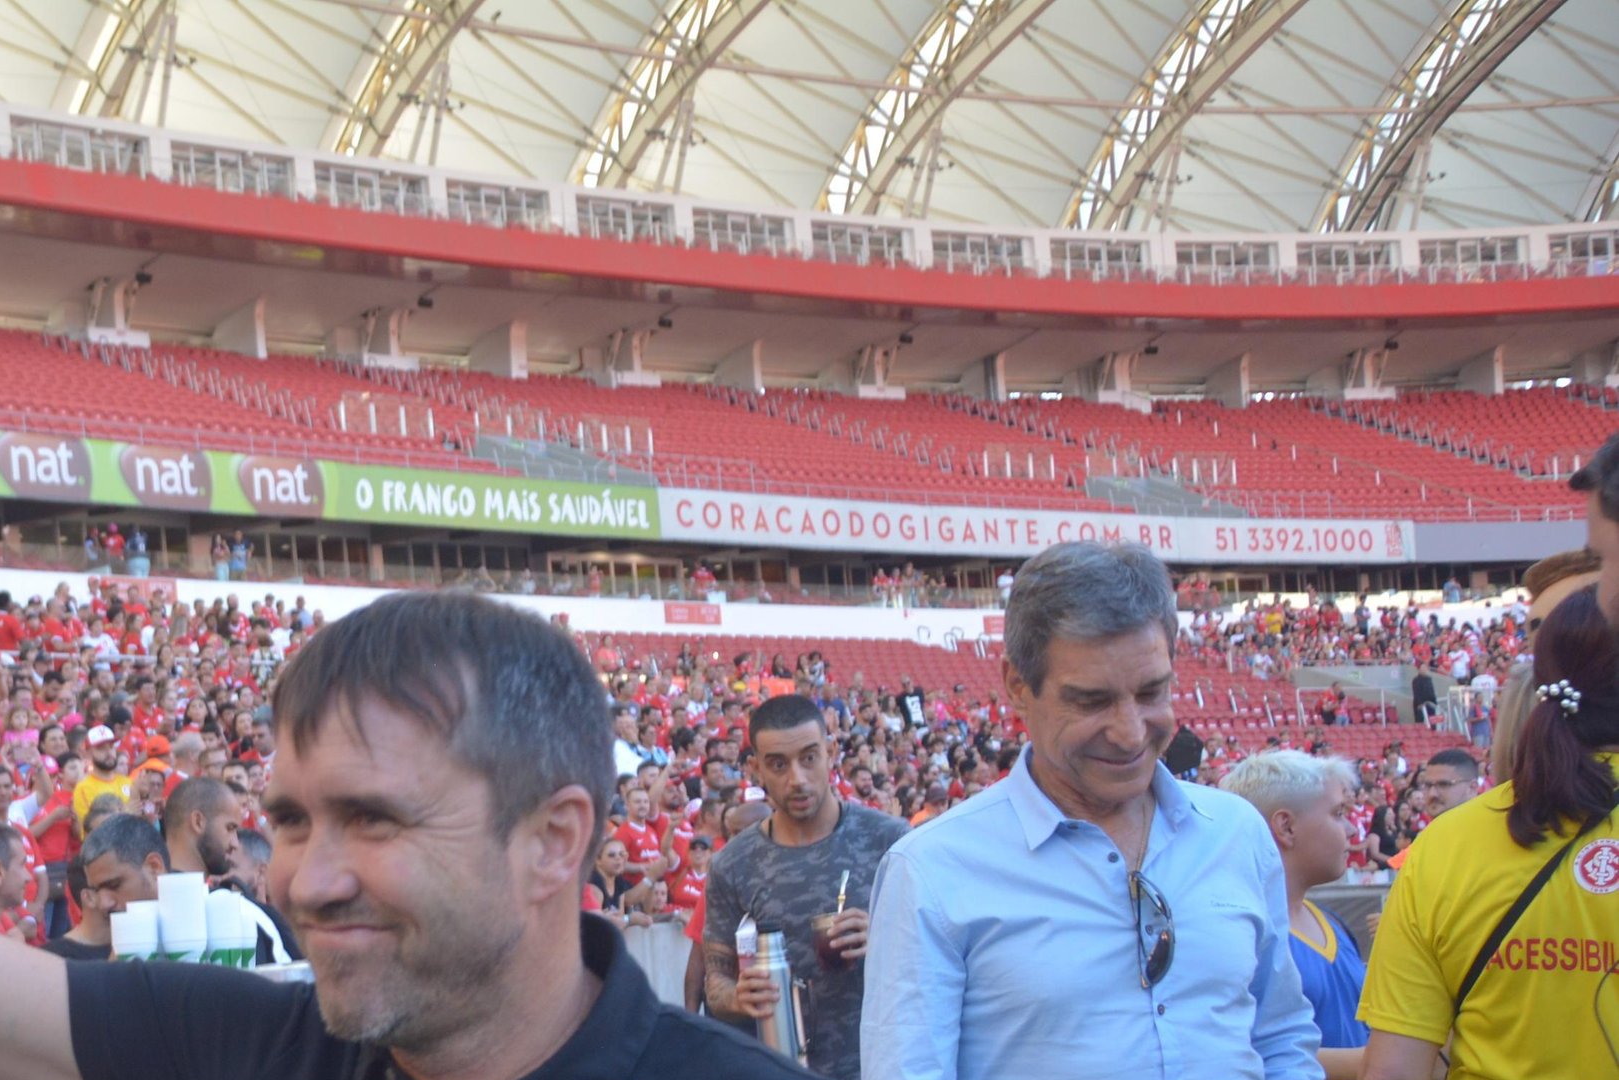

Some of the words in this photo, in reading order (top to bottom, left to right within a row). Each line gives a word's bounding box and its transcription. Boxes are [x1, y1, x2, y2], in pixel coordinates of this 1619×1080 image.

[355, 478, 373, 511] O
[383, 481, 475, 516] FRANGO
[548, 489, 650, 529] SAUDÁVEL
[676, 499, 1174, 550] CORACAODOGIGANTE.COMBR
[1215, 527, 1238, 551] 51
[1248, 527, 1374, 552] 3392.1000
